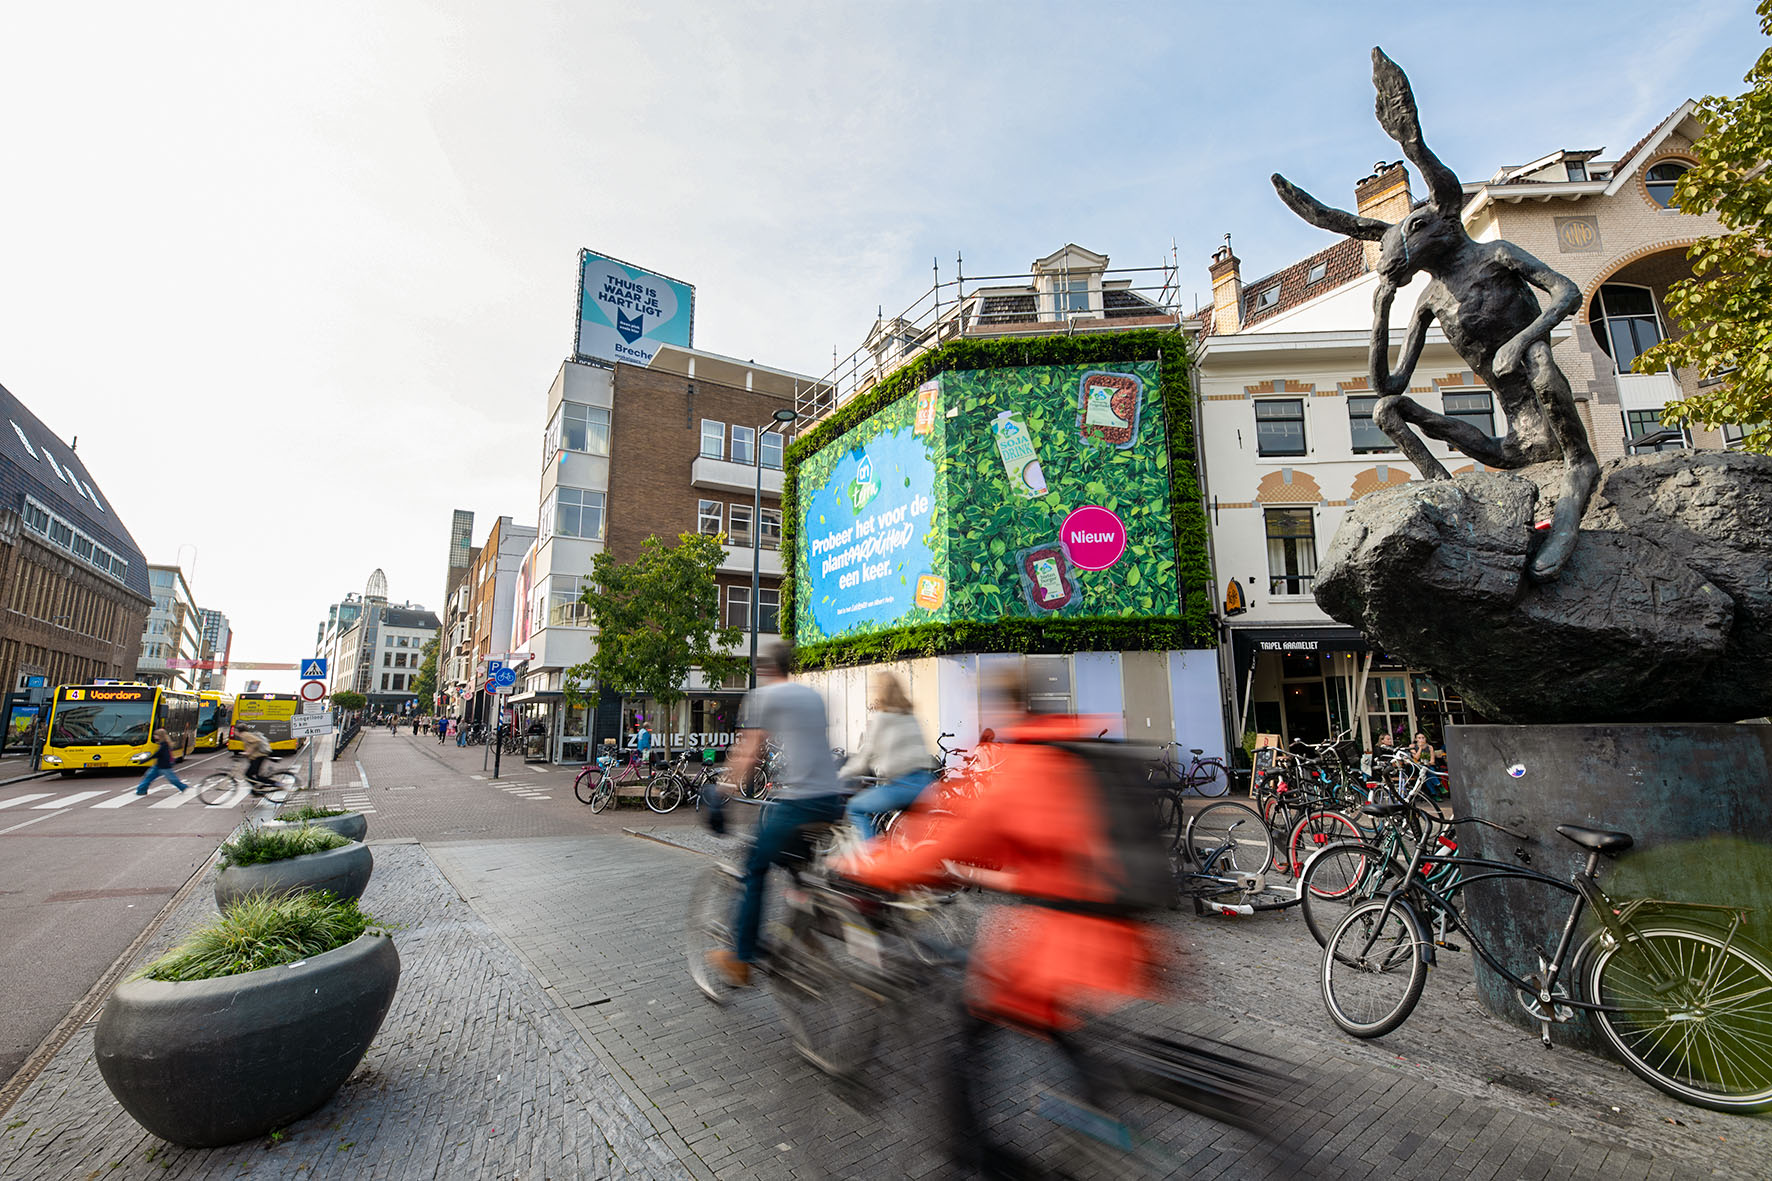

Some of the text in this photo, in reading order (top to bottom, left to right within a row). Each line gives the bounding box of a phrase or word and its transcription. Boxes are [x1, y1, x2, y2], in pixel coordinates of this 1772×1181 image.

[607, 275, 657, 297] THUIS IS
[599, 292, 662, 318] HART LIGT
[604, 284, 659, 308] WAAR JE
[615, 343, 653, 361] Breche
[1000, 435, 1030, 450] SOJA
[1002, 443, 1033, 462] DRINK
[812, 494, 929, 557] Probeer het voor de
[1070, 530, 1115, 544] Nieuw
[839, 559, 893, 590] een keer.
[1260, 641, 1319, 650] TRIPEL KARMELIET
[492, 662, 500, 671] P
[72, 690, 142, 700] 4 Voordorp
